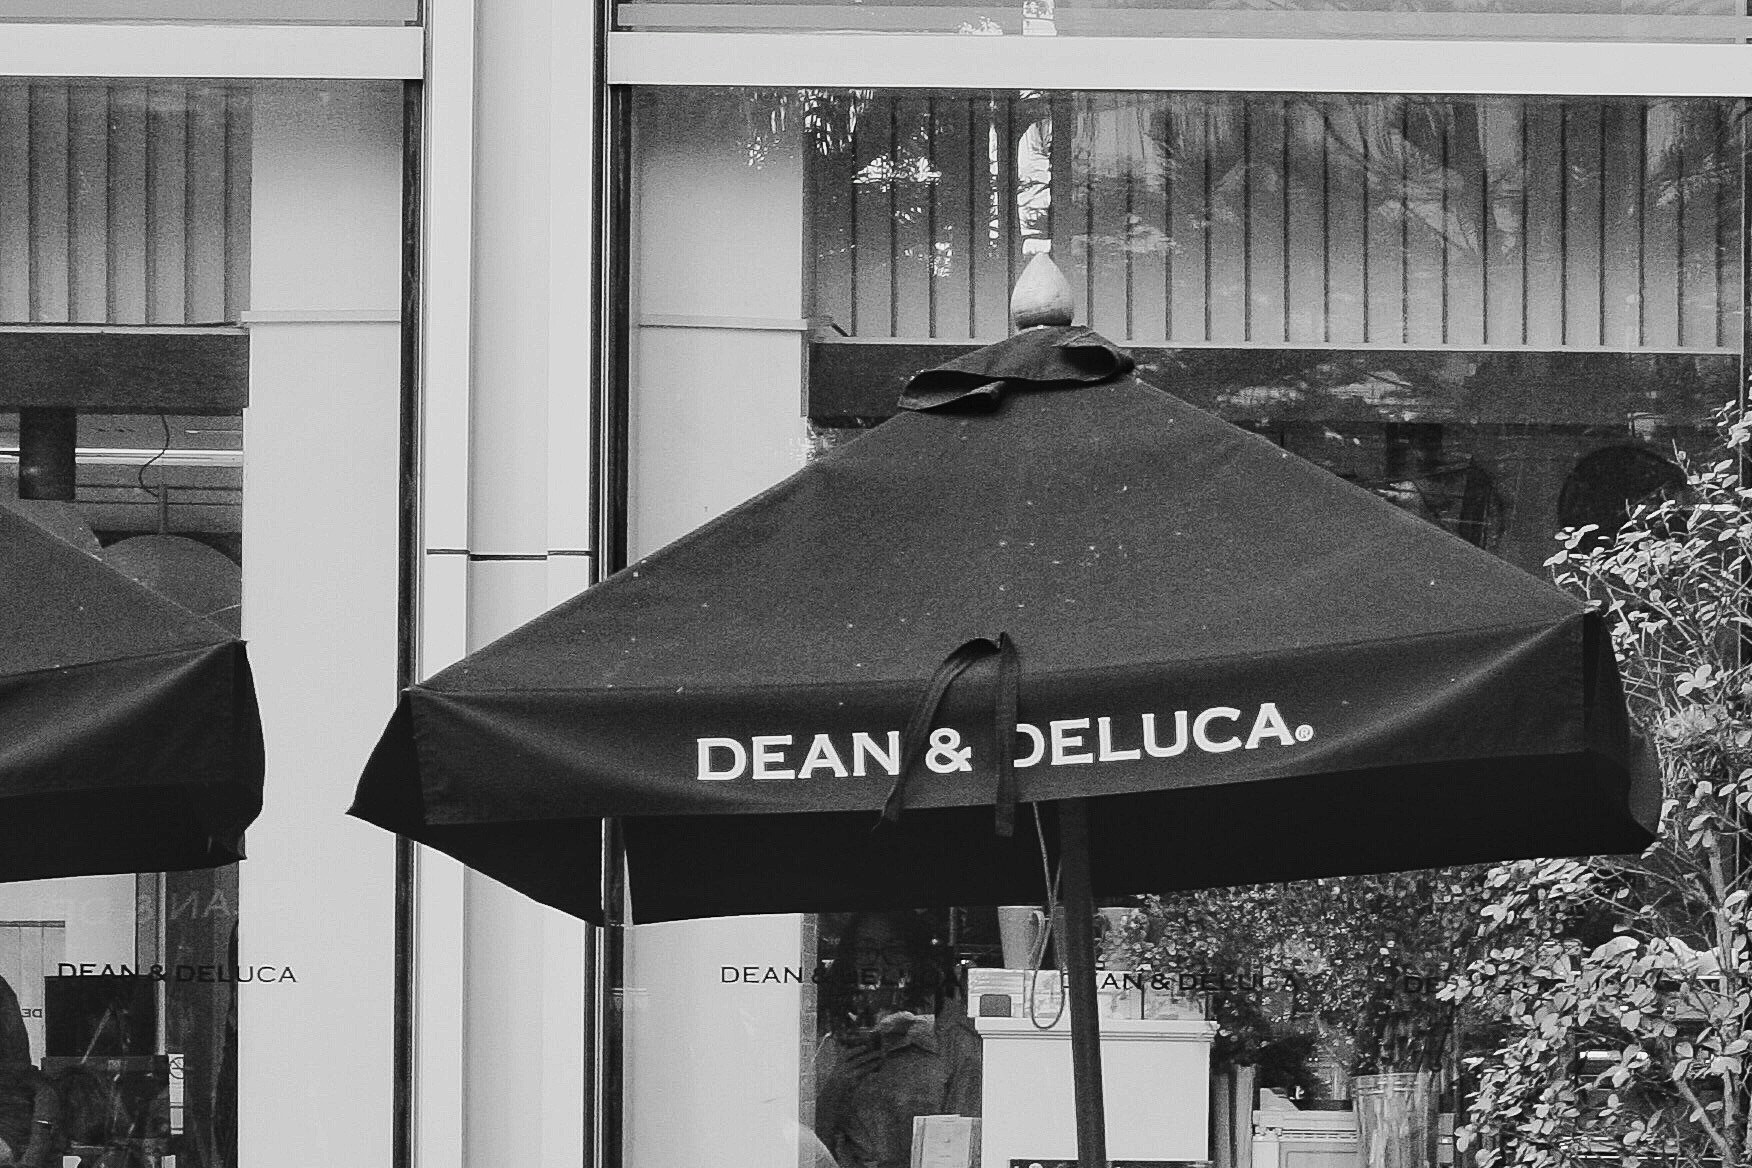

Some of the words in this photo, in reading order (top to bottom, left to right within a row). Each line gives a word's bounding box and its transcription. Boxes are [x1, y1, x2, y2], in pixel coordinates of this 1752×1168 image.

[697, 730, 900, 781] DEAN
[925, 727, 973, 774] &
[151, 963, 167, 982] &
[175, 964, 297, 983] DELUCA
[720, 966, 803, 984] DEAN
[1151, 972, 1171, 990] &
